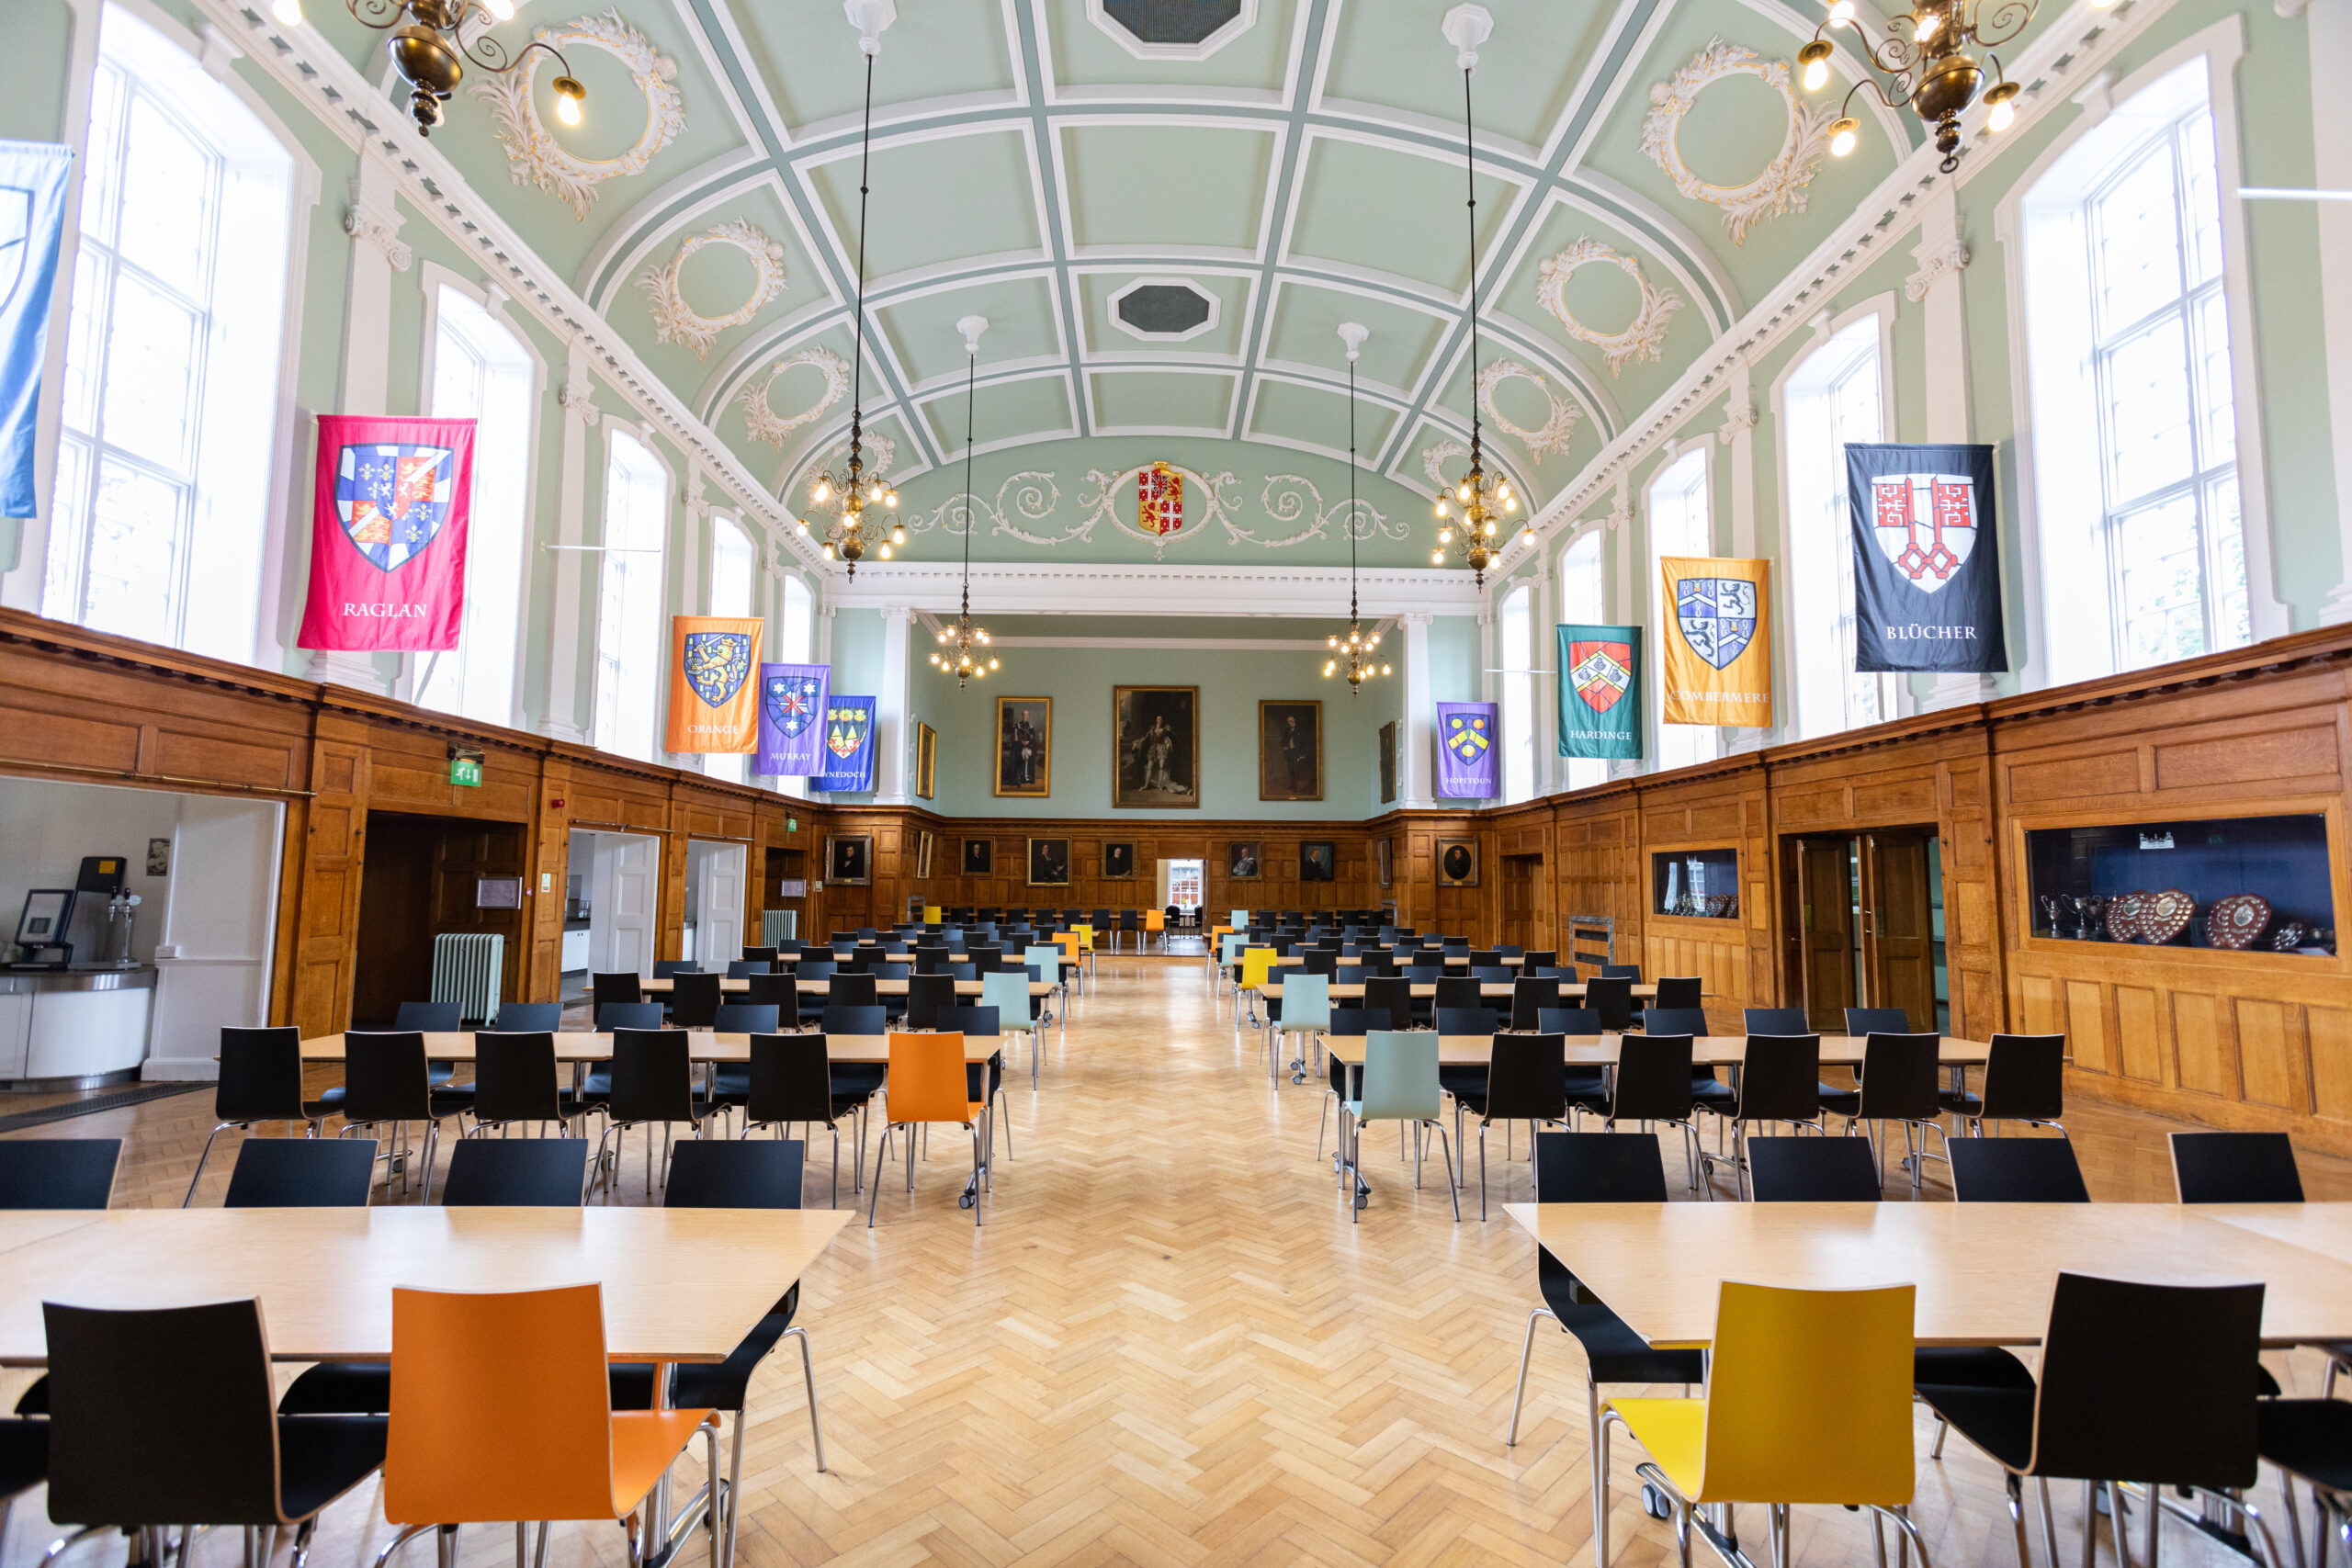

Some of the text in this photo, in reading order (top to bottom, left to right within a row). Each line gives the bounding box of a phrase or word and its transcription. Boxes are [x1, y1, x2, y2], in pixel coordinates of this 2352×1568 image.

[342, 602, 427, 618] RAGLAN
[1886, 623, 1977, 640] BLÜCHER
[1669, 690, 1770, 704] COMBERMERE
[687, 724, 739, 734] ORANGE
[1570, 729, 1633, 740] HARDINGE
[770, 752, 811, 761] MURRAY
